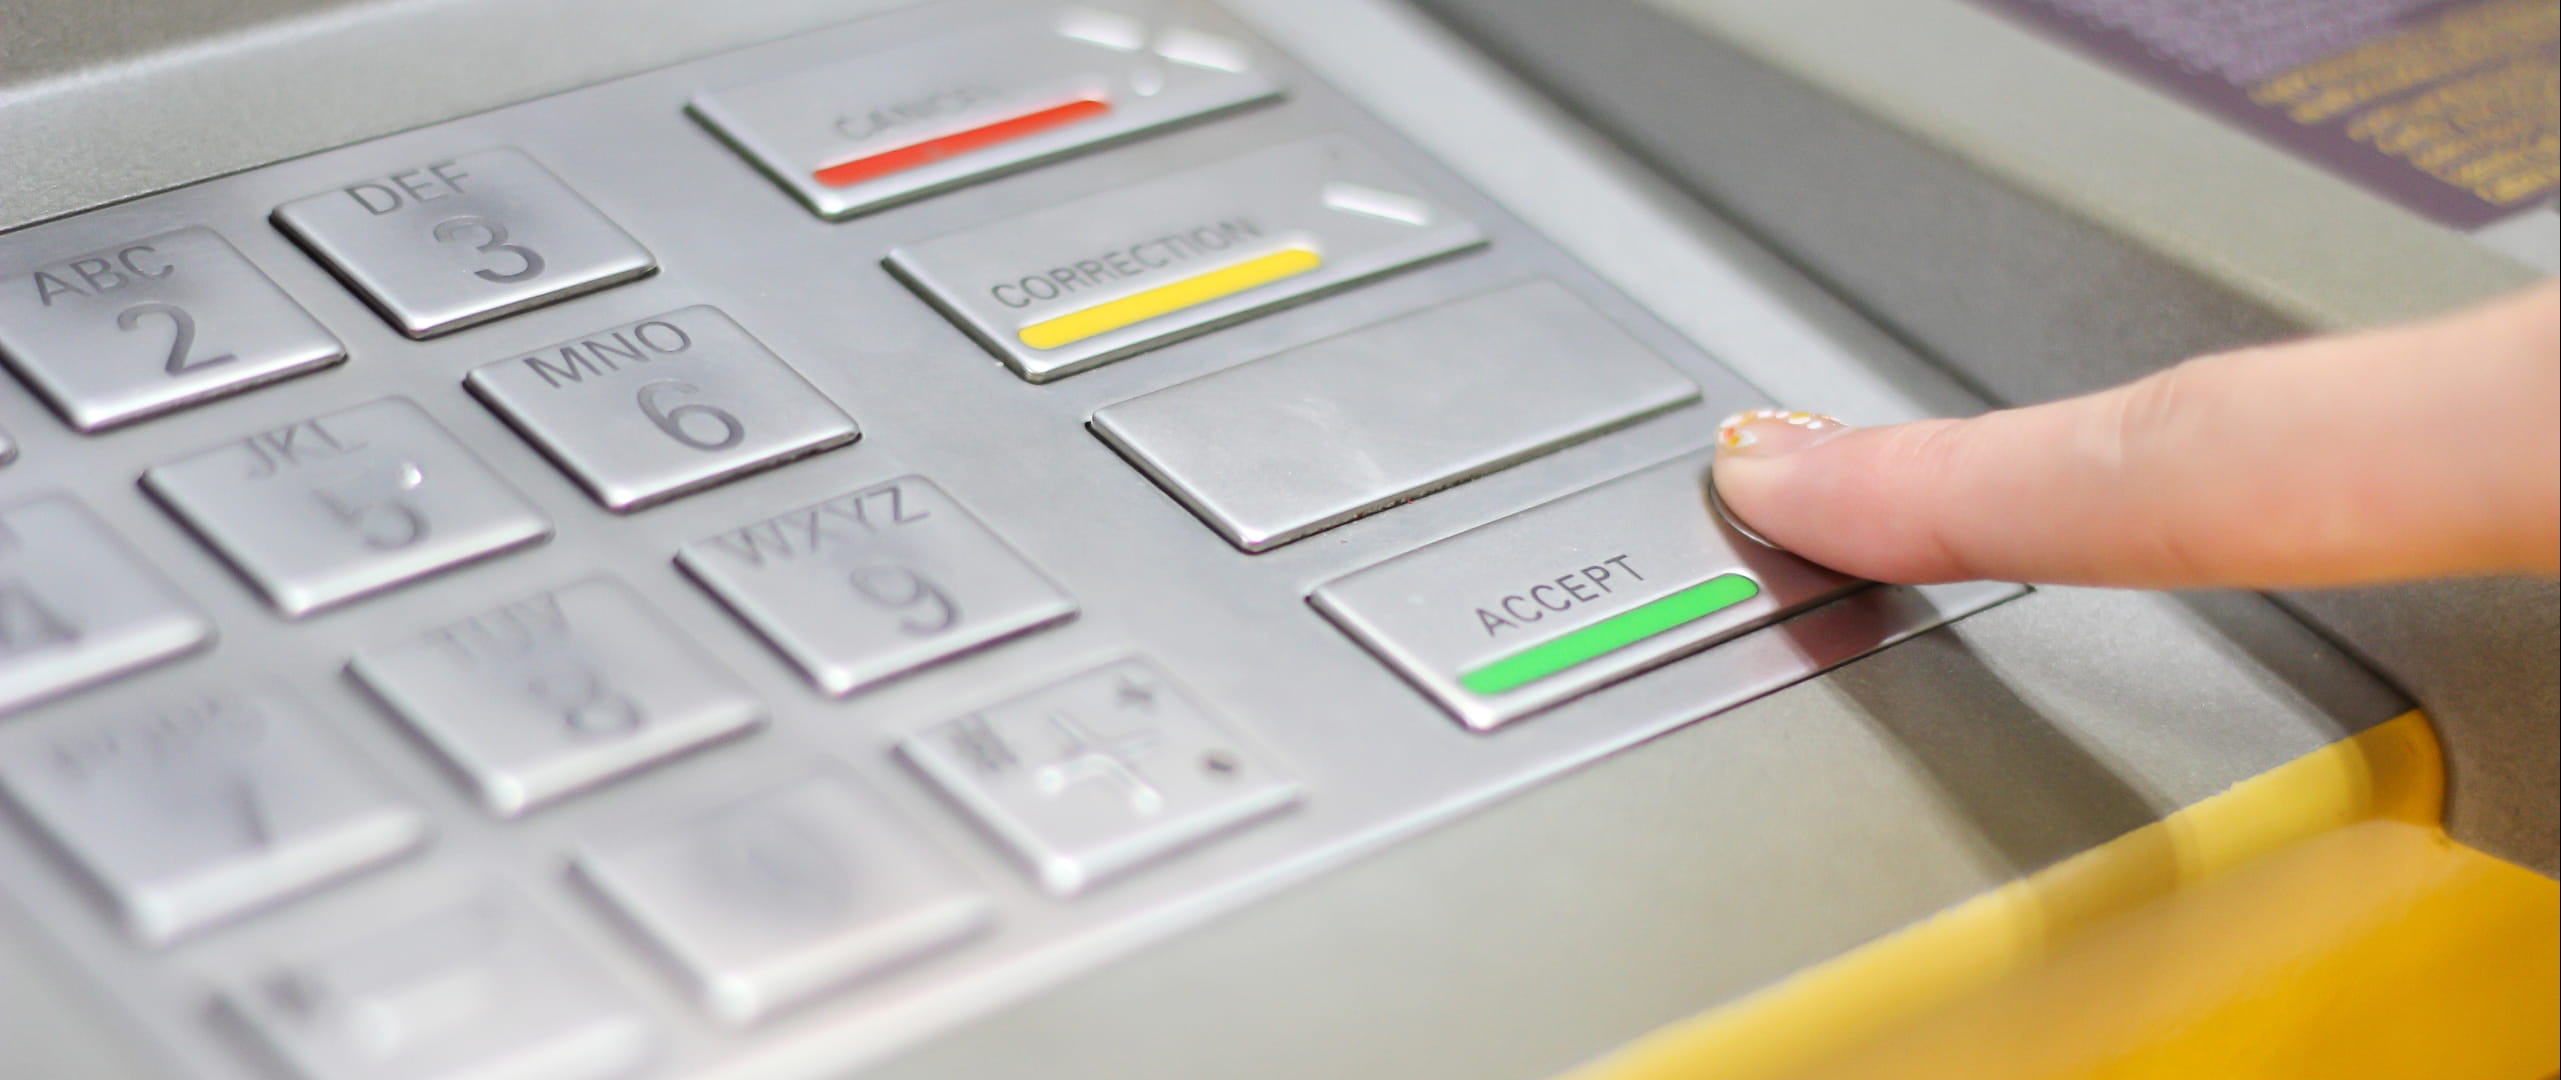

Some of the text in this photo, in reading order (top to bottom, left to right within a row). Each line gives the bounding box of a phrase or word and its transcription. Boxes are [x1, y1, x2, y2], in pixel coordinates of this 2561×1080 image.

[345, 161, 470, 216] DEF
[33, 244, 174, 306] ABC
[433, 214, 545, 284] 3
[990, 216, 1263, 310] CORRECTION
[117, 303, 237, 374] 2
[522, 319, 692, 389] MNO
[635, 377, 744, 452] 6
[244, 421, 370, 480] JKL
[714, 485, 931, 568] WXYZ
[850, 564, 962, 637] 9
[1474, 553, 1646, 638] ACCEPT
